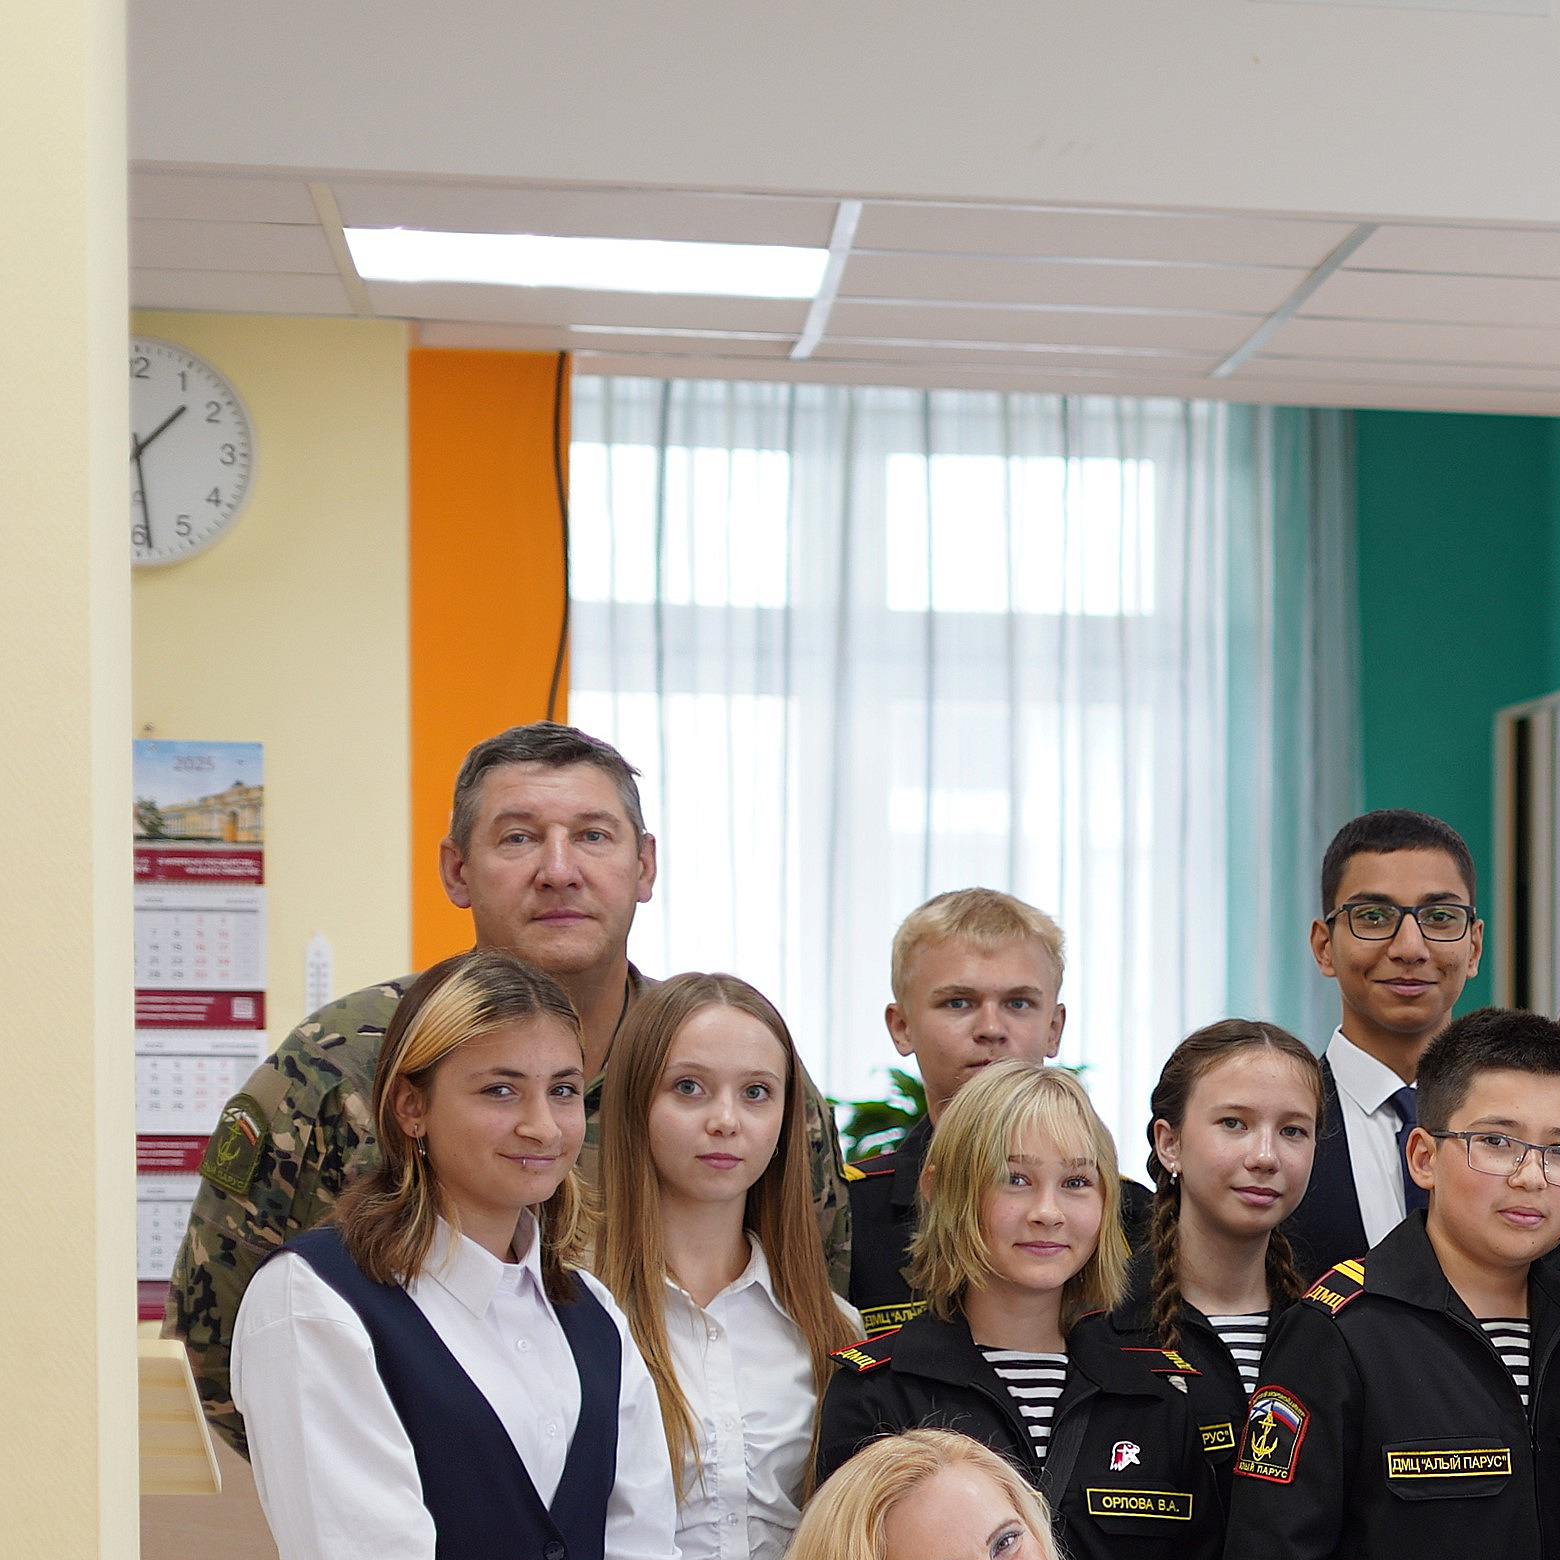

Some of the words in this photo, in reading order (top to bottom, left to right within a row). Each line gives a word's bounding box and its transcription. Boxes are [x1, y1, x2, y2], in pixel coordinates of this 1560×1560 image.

[177, 370, 187, 392] 1
[205, 400, 222, 424] 2
[219, 443, 237, 466] 3
[205, 486, 222, 507] 4
[131, 523, 149, 546] 6
[174, 513, 192, 537] 5
[1305, 1284, 1346, 1311] ДМЦ
[1201, 1429, 1230, 1446] РУС"
[1256, 1464, 1289, 1479] ПАРУС
[1392, 1457, 1421, 1473] ДМЦ
[1101, 1495, 1155, 1511] ОРЛОВА
[1158, 1499, 1180, 1513] В.А.
